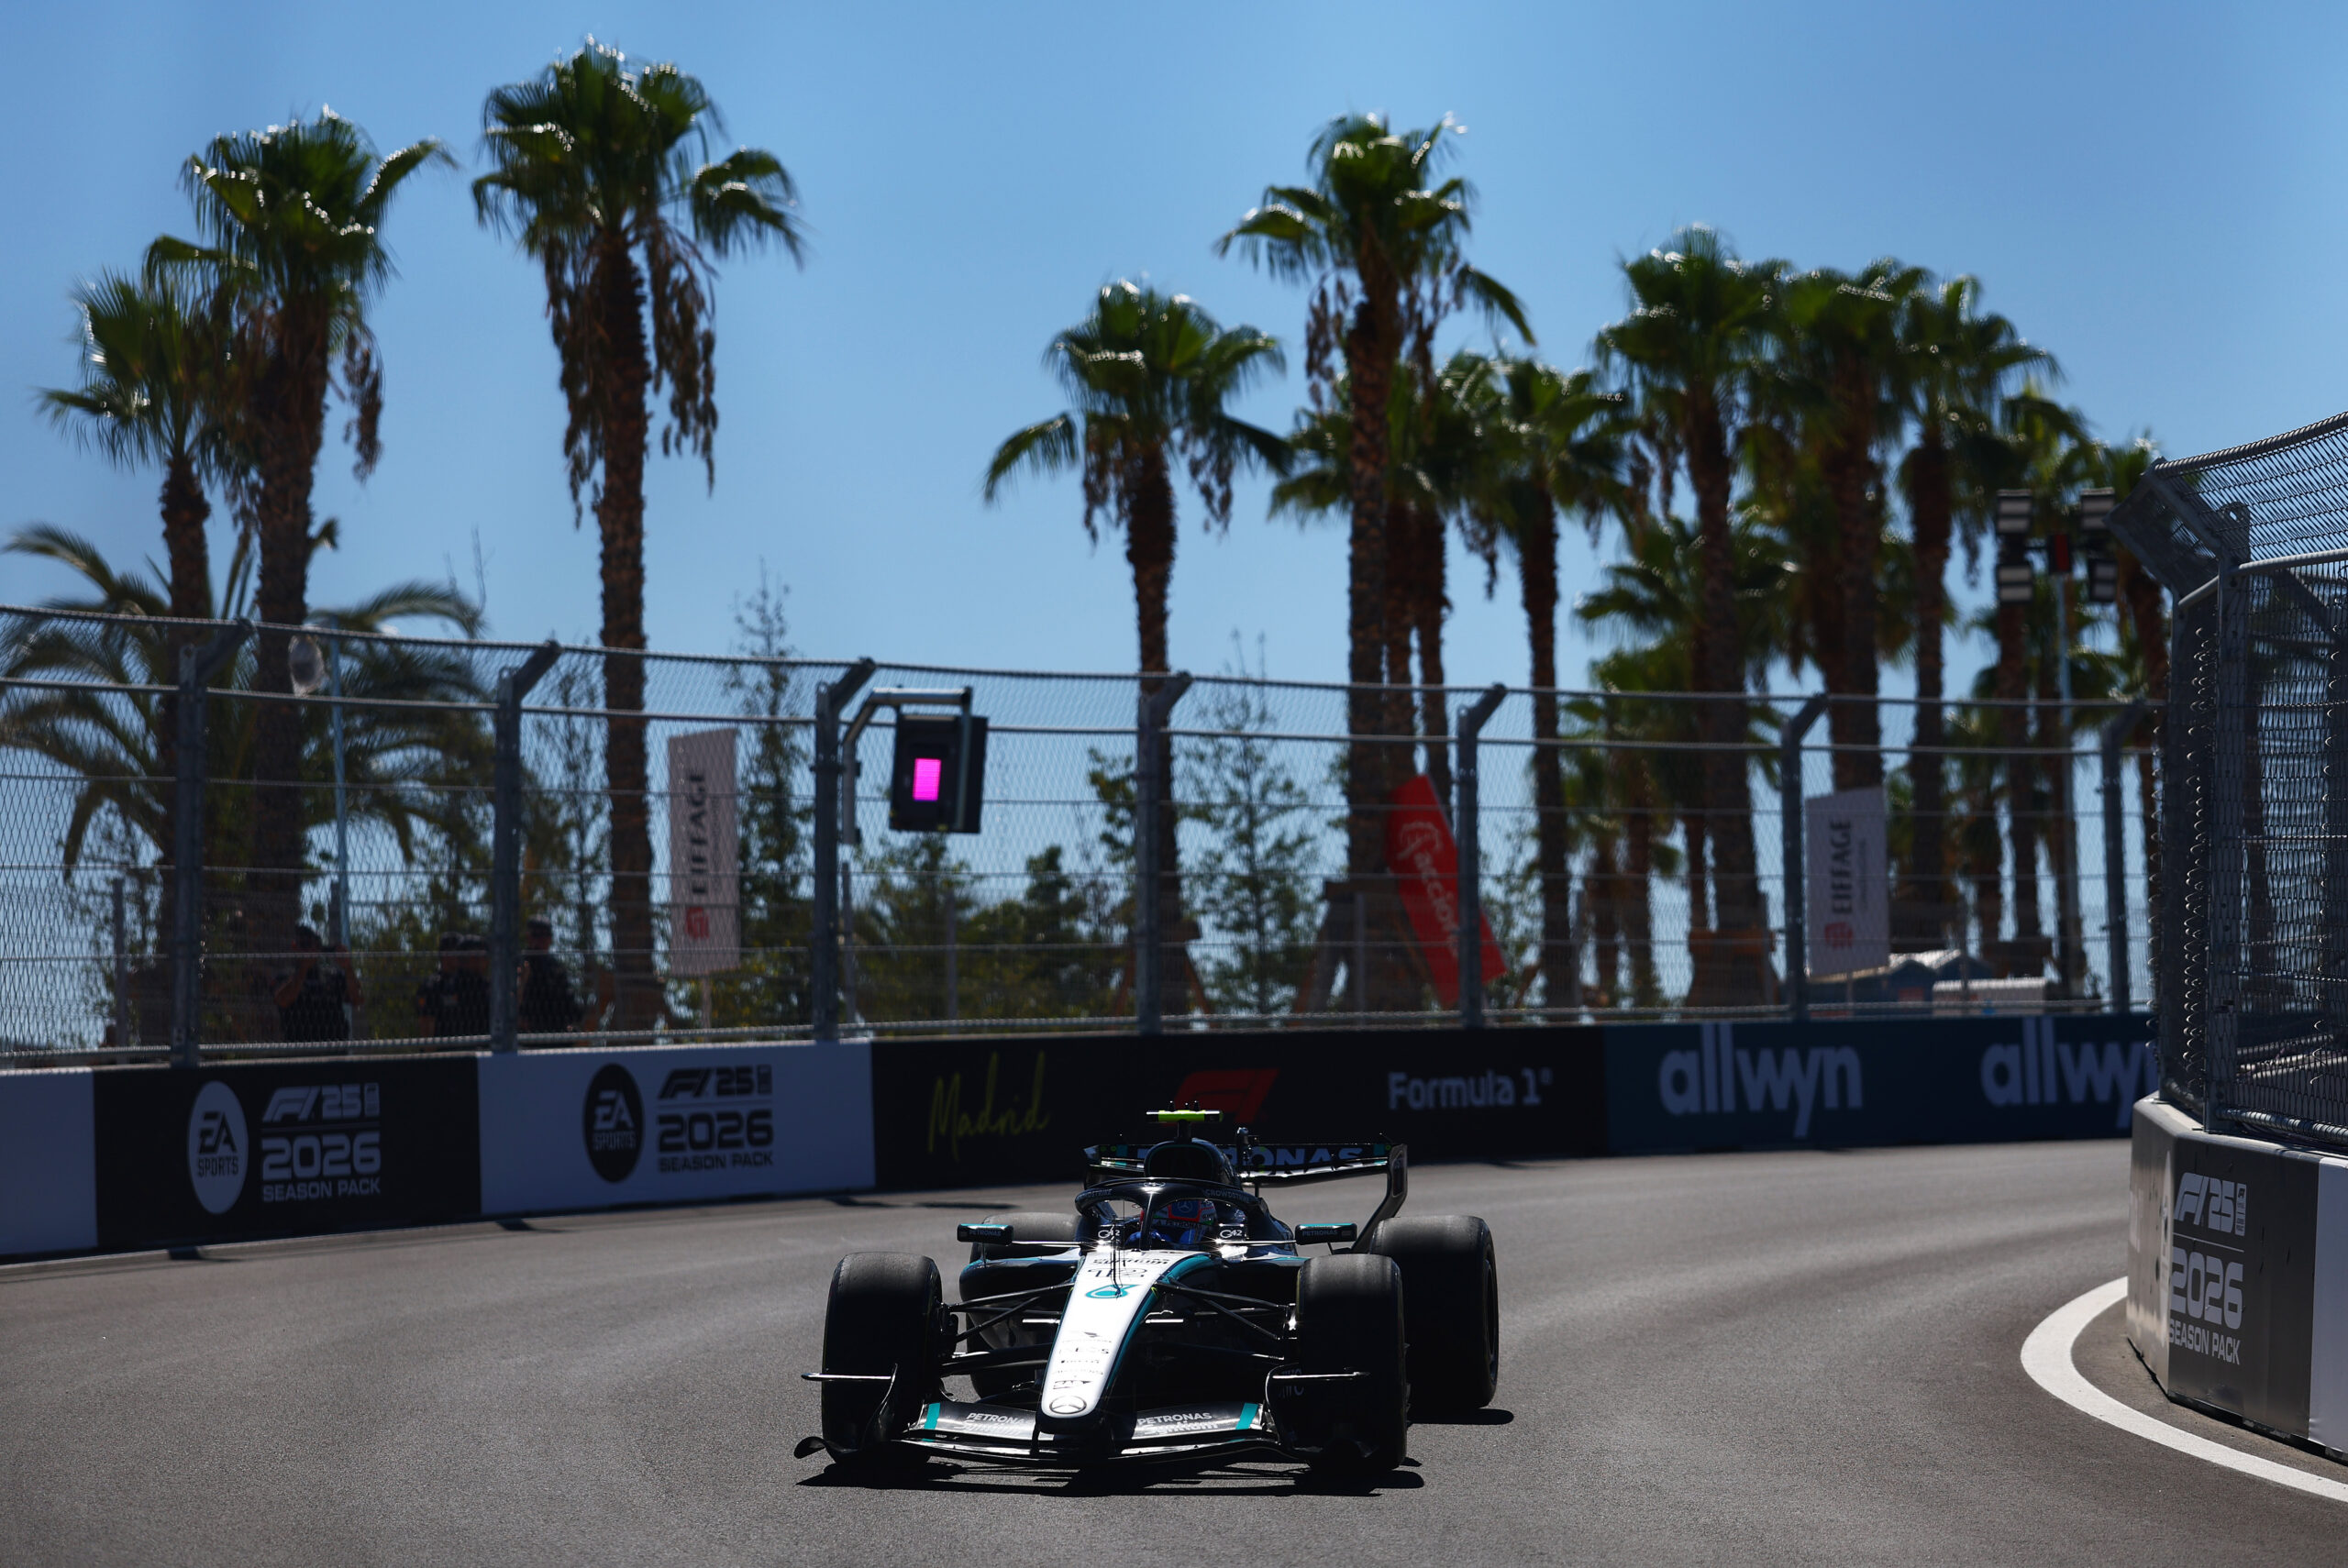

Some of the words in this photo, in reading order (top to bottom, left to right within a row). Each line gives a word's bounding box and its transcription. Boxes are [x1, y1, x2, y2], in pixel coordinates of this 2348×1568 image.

[1830, 821, 1853, 915] EIFFAGE
[1388, 1067, 1515, 1110] Formula
[1659, 1020, 1864, 1139] allwyn
[593, 1089, 635, 1130] EA
[927, 1050, 1050, 1162] Madrid
[198, 1110, 238, 1155] EA
[593, 1130, 637, 1151] SPORTS
[657, 1108, 774, 1154] 2026
[197, 1155, 239, 1178] SPORTS
[261, 1131, 382, 1181] 2026
[659, 1154, 726, 1174] SEASON
[731, 1151, 774, 1168] PACK
[263, 1180, 333, 1203] SEASON
[338, 1176, 382, 1198] PACK
[2208, 1176, 2235, 1233] 25
[1219, 1229, 1243, 1239] G42
[2170, 1246, 2243, 1330] 2026
[2169, 1319, 2210, 1355] SEASON
[2211, 1332, 2242, 1365] PACK
[1136, 1412, 1213, 1426] PETRONAS
